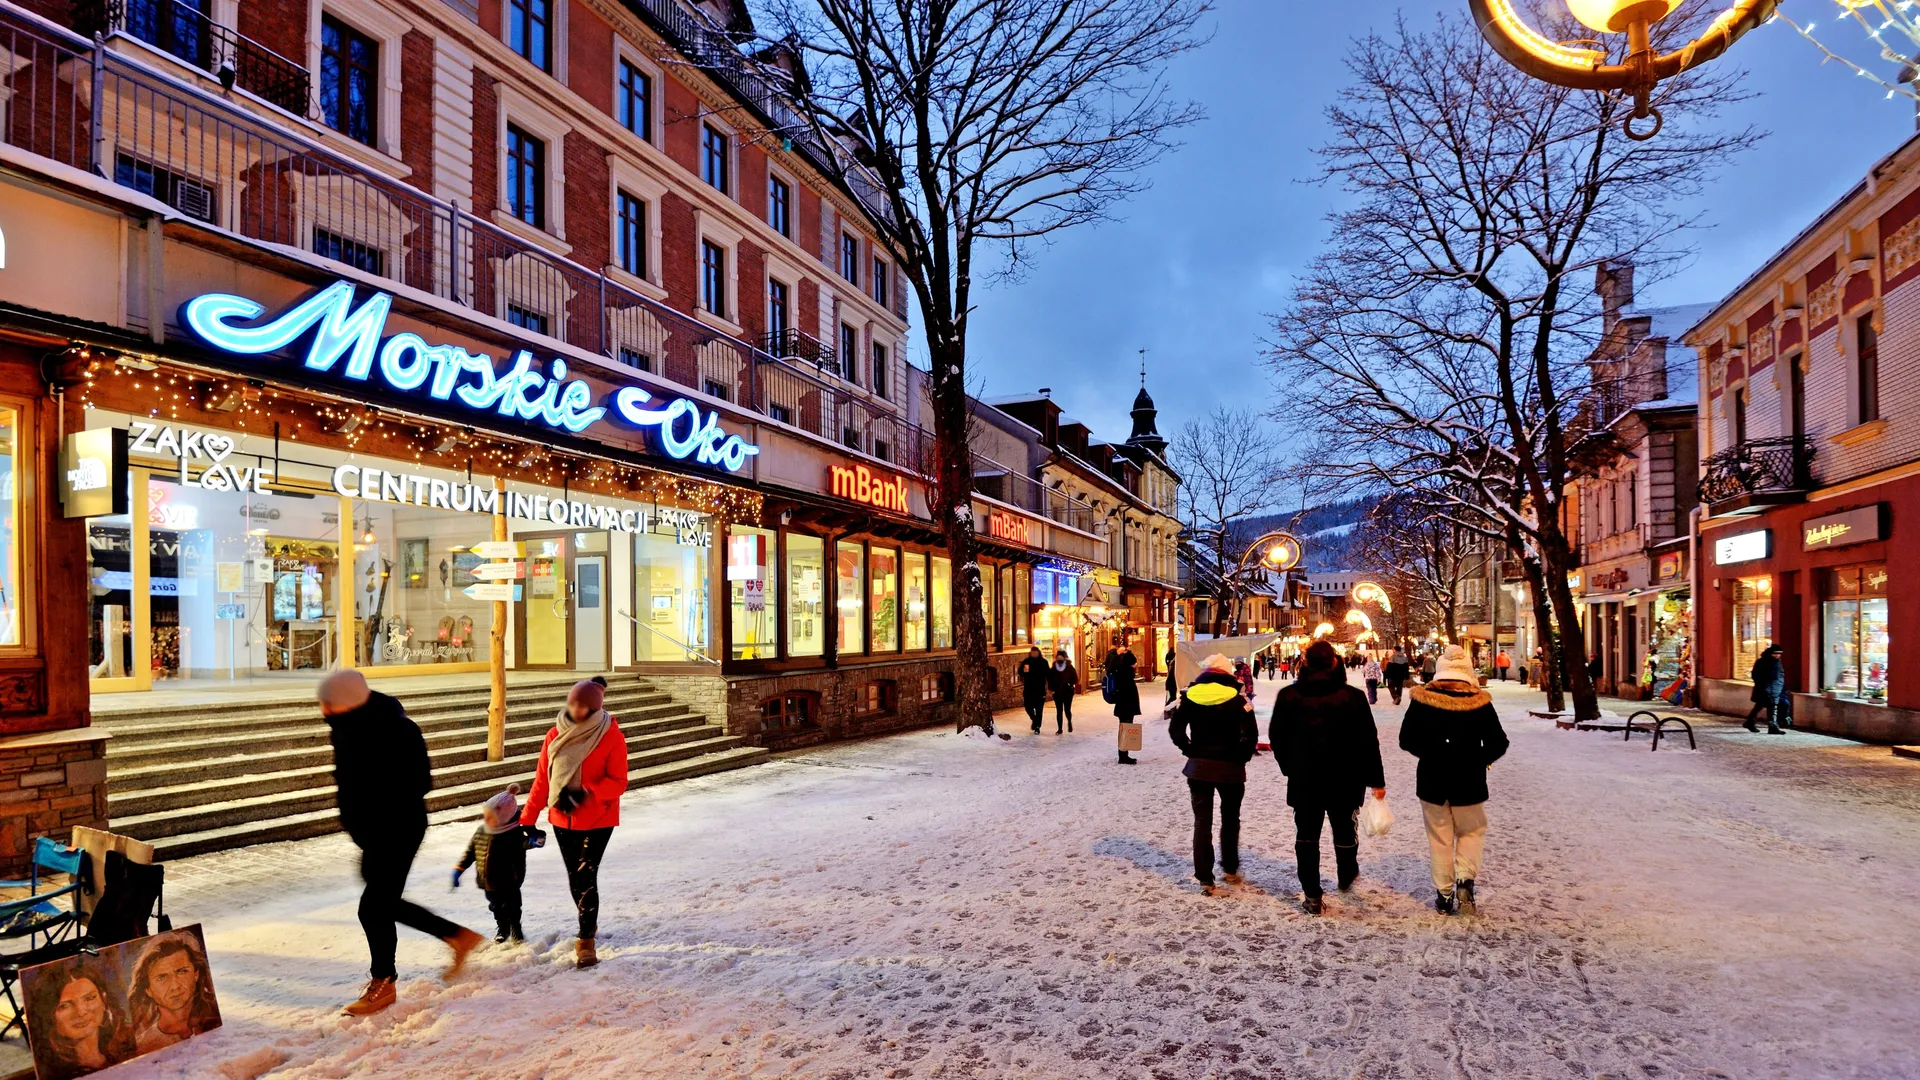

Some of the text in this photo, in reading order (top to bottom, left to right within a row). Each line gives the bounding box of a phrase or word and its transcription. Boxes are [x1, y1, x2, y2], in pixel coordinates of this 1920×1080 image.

[186, 279, 760, 472] Morskie Oko
[333, 464, 499, 516] CENTRUM
[506, 490, 648, 535] INFORMACJI
[830, 464, 909, 515] mBank
[990, 513, 1029, 545] mBank
